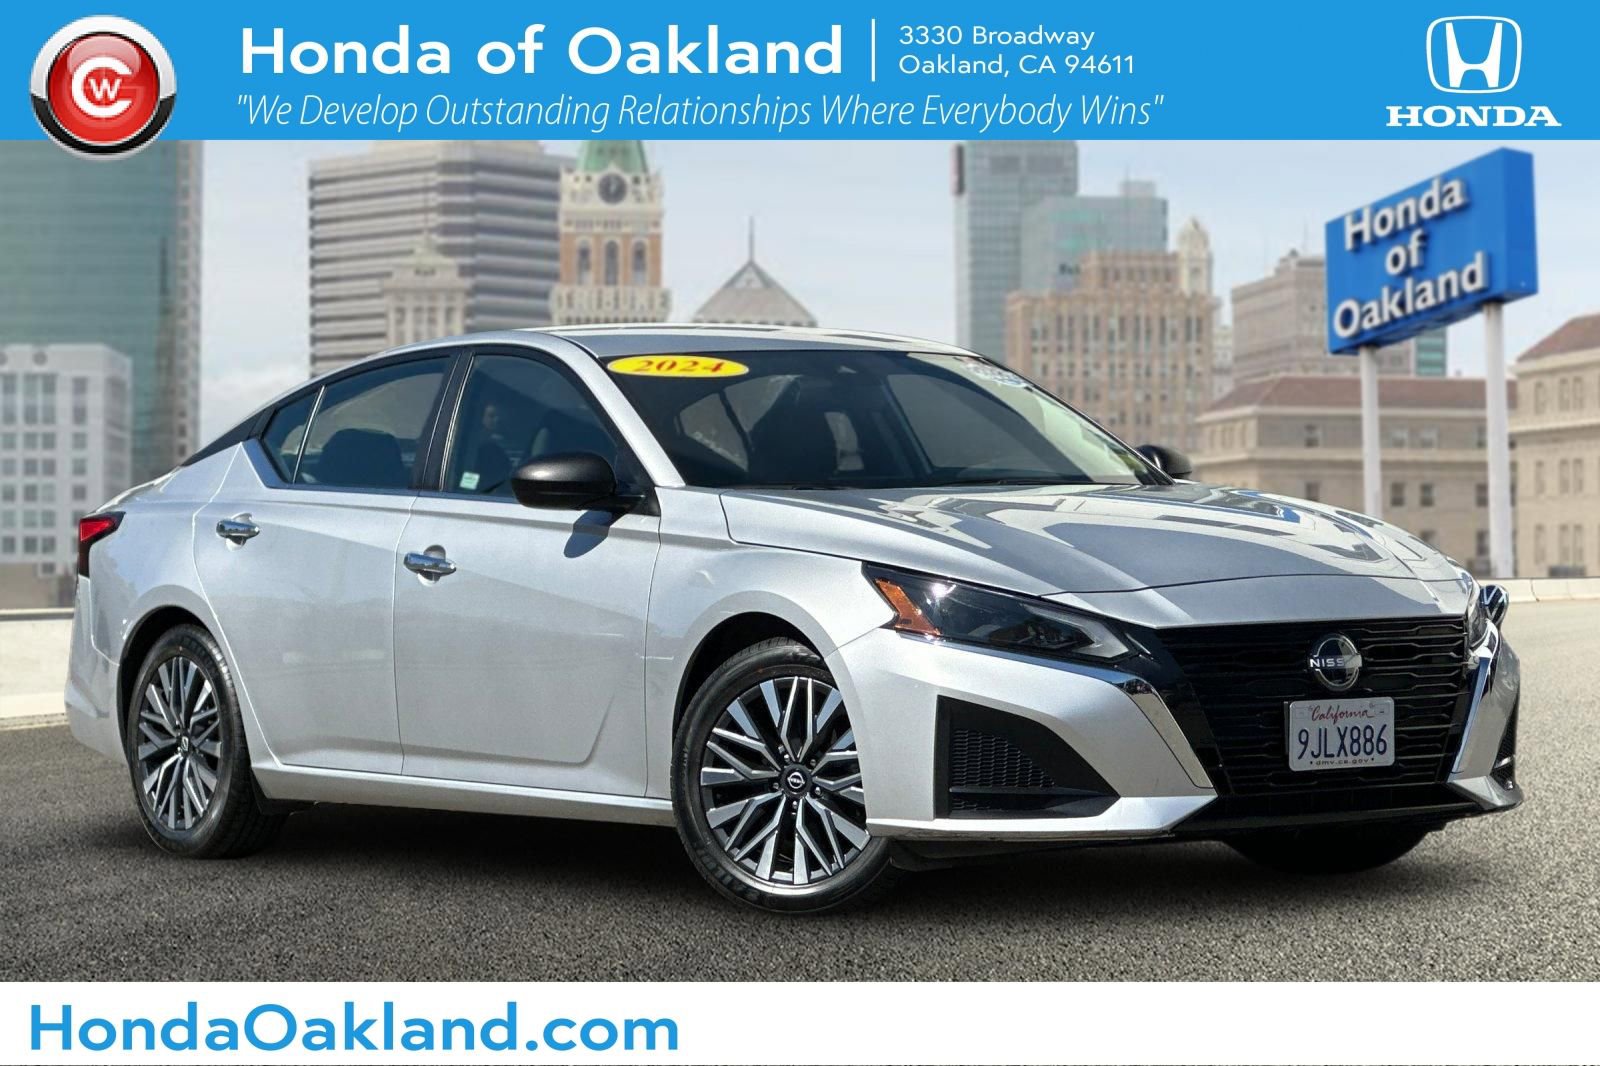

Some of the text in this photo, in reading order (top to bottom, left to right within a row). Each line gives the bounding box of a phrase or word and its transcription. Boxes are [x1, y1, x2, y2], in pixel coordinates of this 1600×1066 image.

[1344, 176, 1467, 251] Honda
[1385, 229, 1426, 275] of
[1333, 251, 1488, 338] Oakland
[633, 359, 724, 374] 2024
[1309, 657, 1360, 668] NISS
[1310, 705, 1375, 725] California
[1297, 723, 1387, 760] 9JLX886
